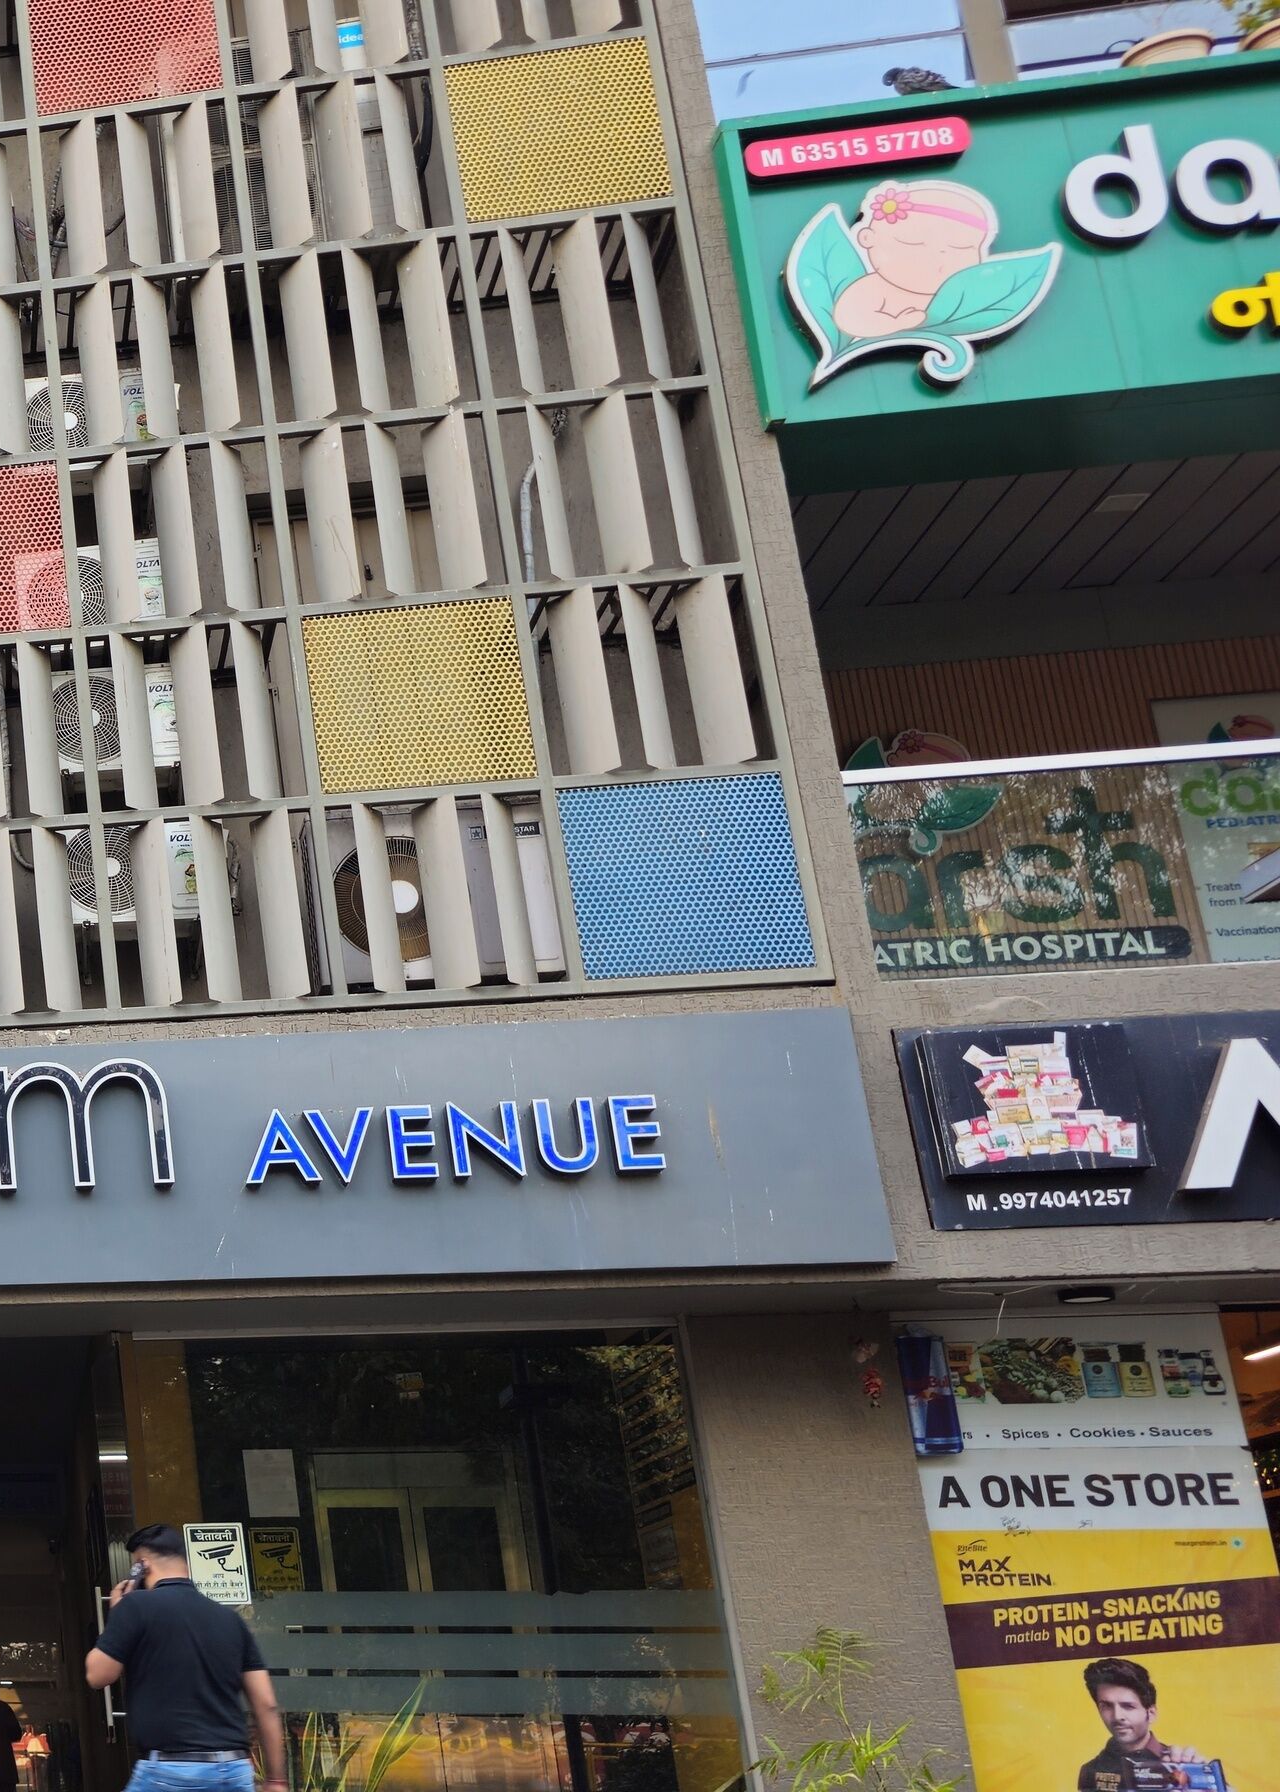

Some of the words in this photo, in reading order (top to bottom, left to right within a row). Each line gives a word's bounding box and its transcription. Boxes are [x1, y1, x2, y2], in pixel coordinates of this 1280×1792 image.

[760, 145, 783, 168] M
[792, 136, 868, 165] 63515
[876, 126, 955, 154] 57708
[986, 931, 1166, 963] HOSPITAL
[244, 1092, 667, 1190] AVENUE
[1001, 1428, 1050, 1440] Spices
[1070, 1427, 1135, 1438] Cookies
[1149, 1426, 1213, 1437] Sauces
[939, 1475, 970, 1508] A
[980, 1473, 1075, 1507] ONE
[1083, 1472, 1240, 1506] STORE
[193, 1529, 233, 1541] चेतावनी
[958, 1556, 1011, 1572] MAX
[961, 1573, 1052, 1586] PROTEIN
[1005, 1629, 1050, 1644] matlab
[1055, 1625, 1091, 1648] NO
[1096, 1613, 1224, 1645] CHEATING
